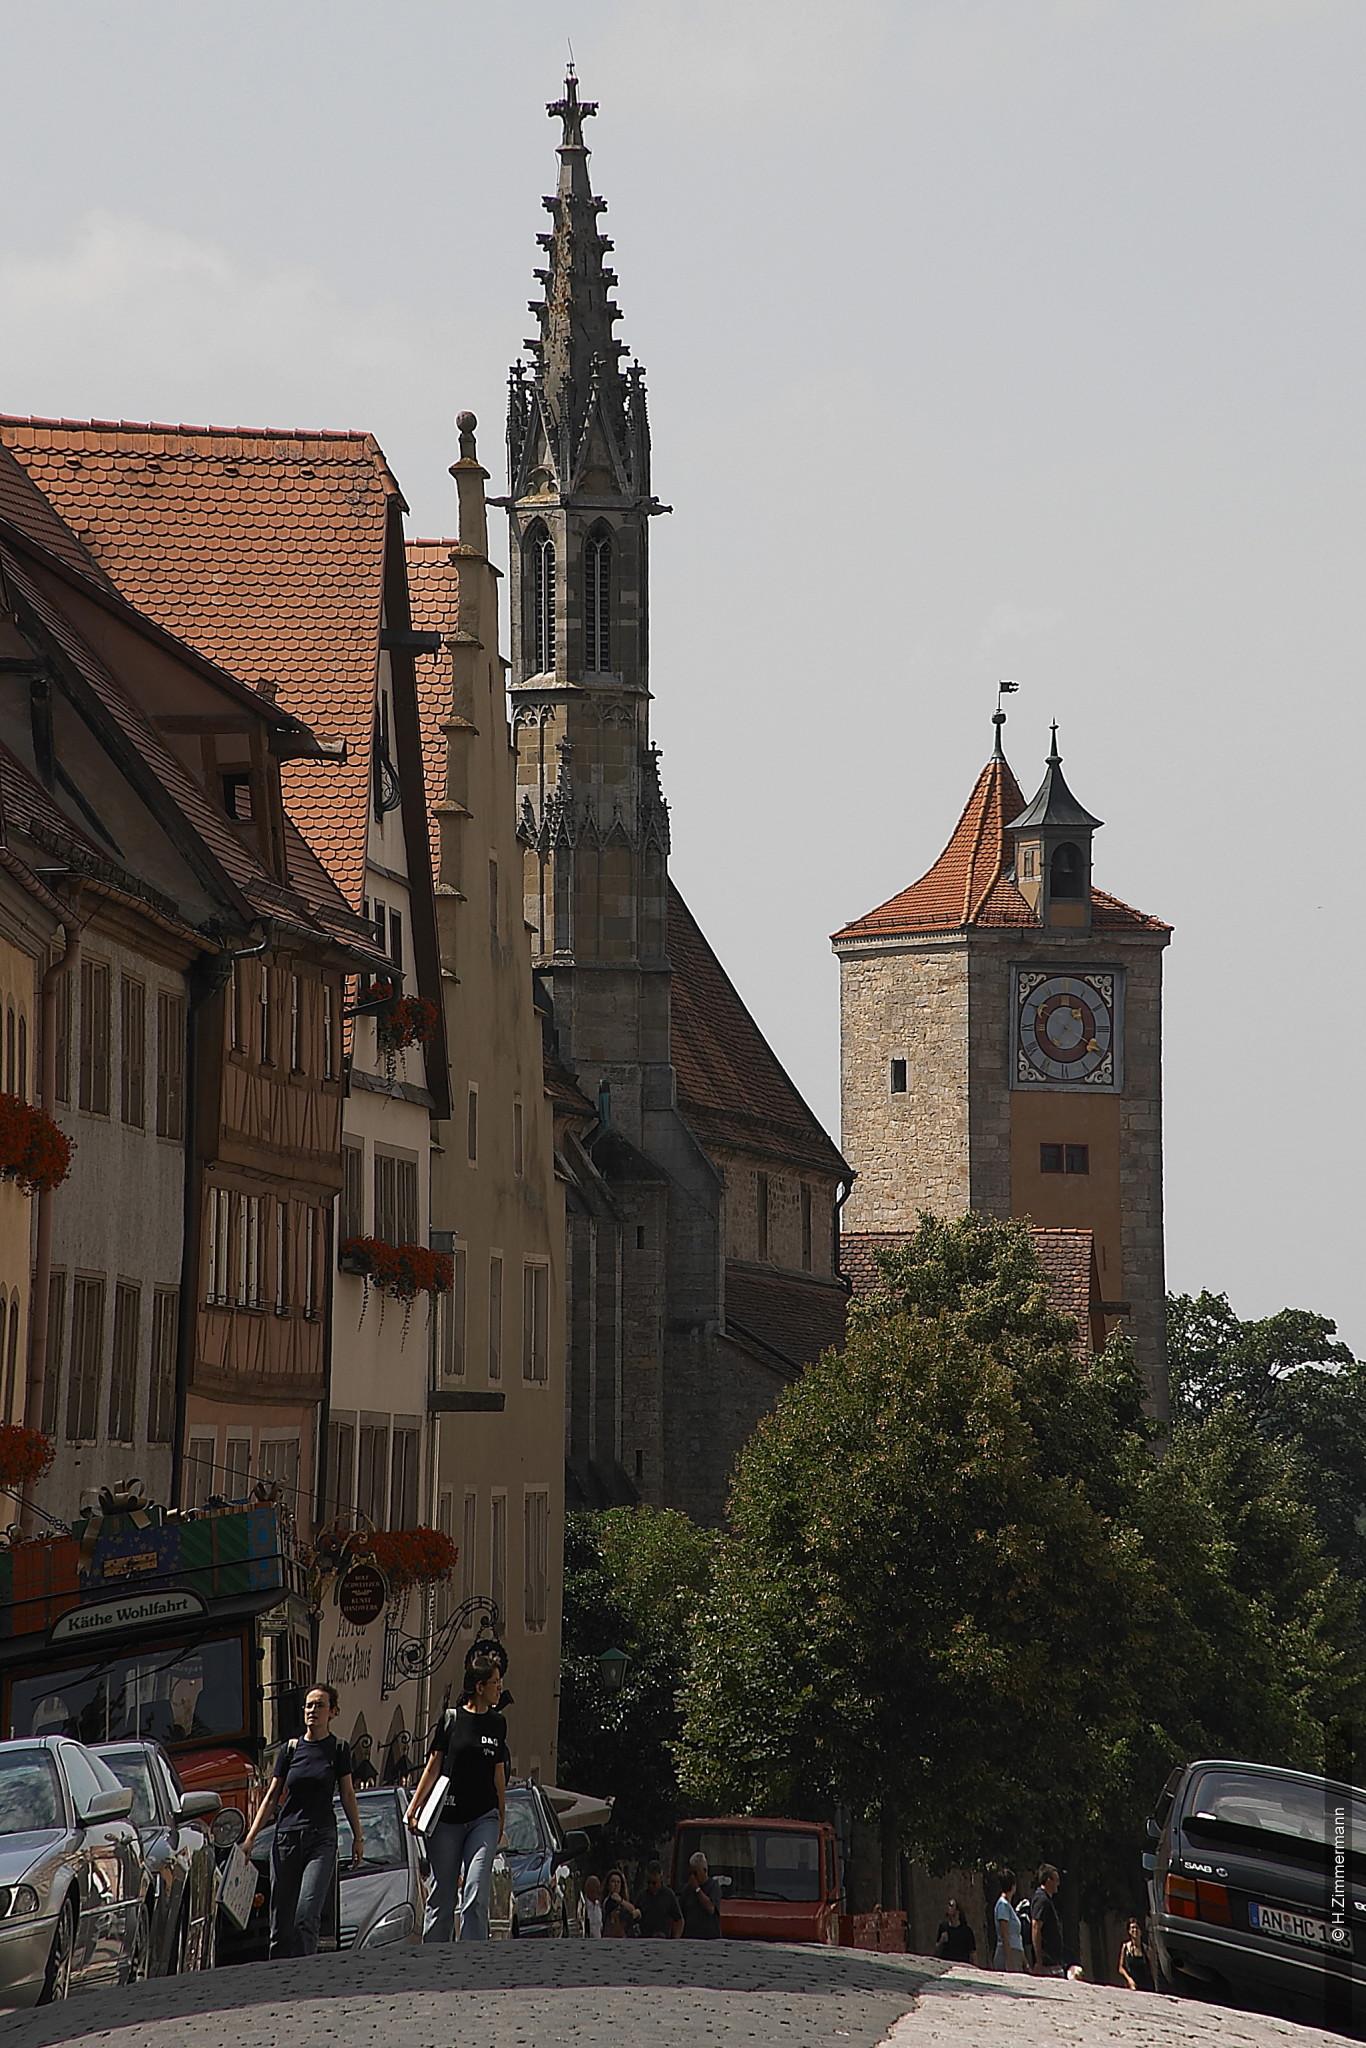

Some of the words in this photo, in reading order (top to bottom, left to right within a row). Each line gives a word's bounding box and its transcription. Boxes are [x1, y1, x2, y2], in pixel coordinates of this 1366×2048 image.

[68, 1613, 113, 1632] Käthe
[116, 1598, 188, 1621] Wohlfahrt
[1184, 1861, 1213, 1874] SAAB
[1261, 1910, 1283, 1931] AN
[1292, 1917, 1316, 1939] HC
